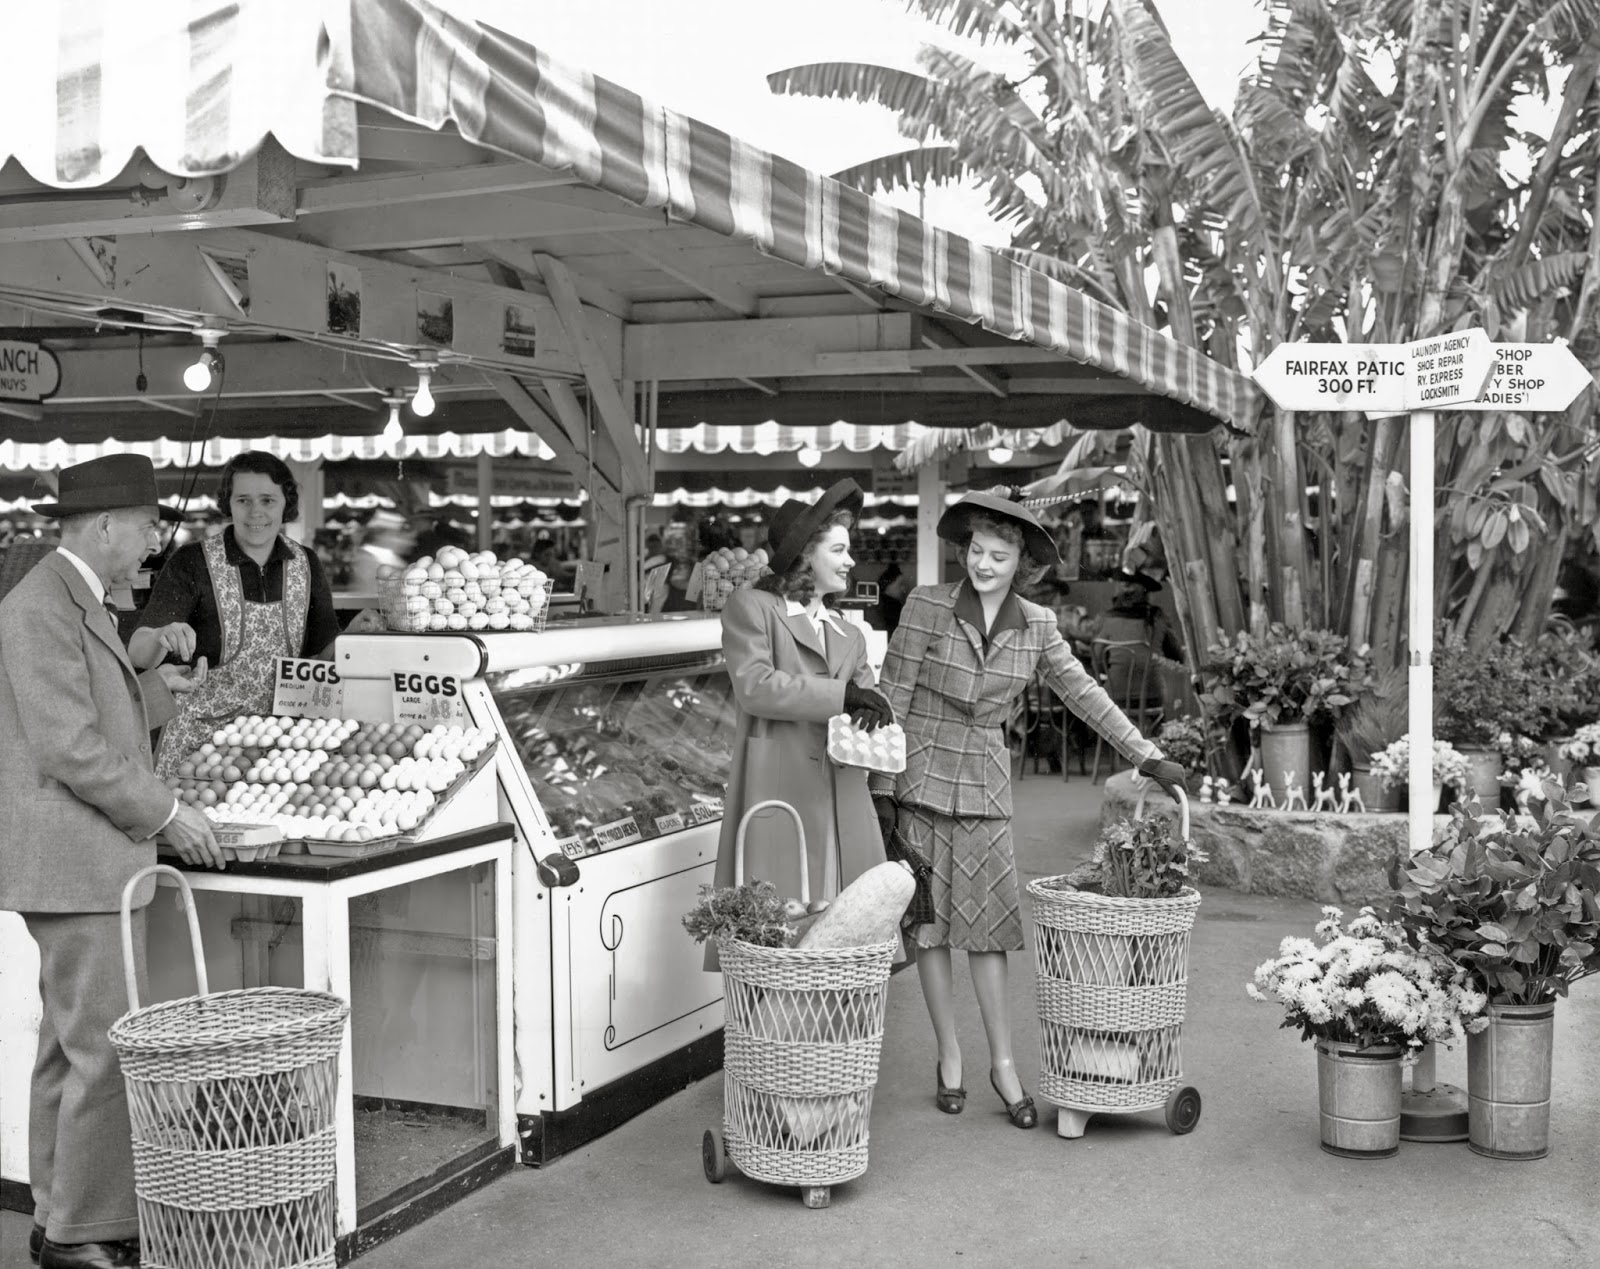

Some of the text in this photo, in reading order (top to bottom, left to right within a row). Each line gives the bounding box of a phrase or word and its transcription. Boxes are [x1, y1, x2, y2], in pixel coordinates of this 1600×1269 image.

[1411, 336, 1470, 359] LAUNDRY AGENCY
[1496, 349, 1533, 361] SHOP
[1285, 360, 1348, 376] FAIRFAX
[1417, 354, 1464, 372] SHOE REPAIR
[1497, 364, 1524, 375] BER
[1, 378, 27, 391] NUYS
[1417, 368, 1463, 386] RY. EXPRESS
[1508, 378, 1545, 390] SHOP
[1318, 379, 1376, 394] 300 FT.
[1420, 384, 1460, 401] LOCKSMITH
[281, 660, 341, 685] EGGS
[394, 672, 457, 697] EGGS
[402, 696, 421, 704] LARGE
[621, 821, 638, 838] HENS
[658, 816, 681, 830] CAPONS
[214, 834, 239, 844] GGS
[559, 840, 584, 857] KEYS
